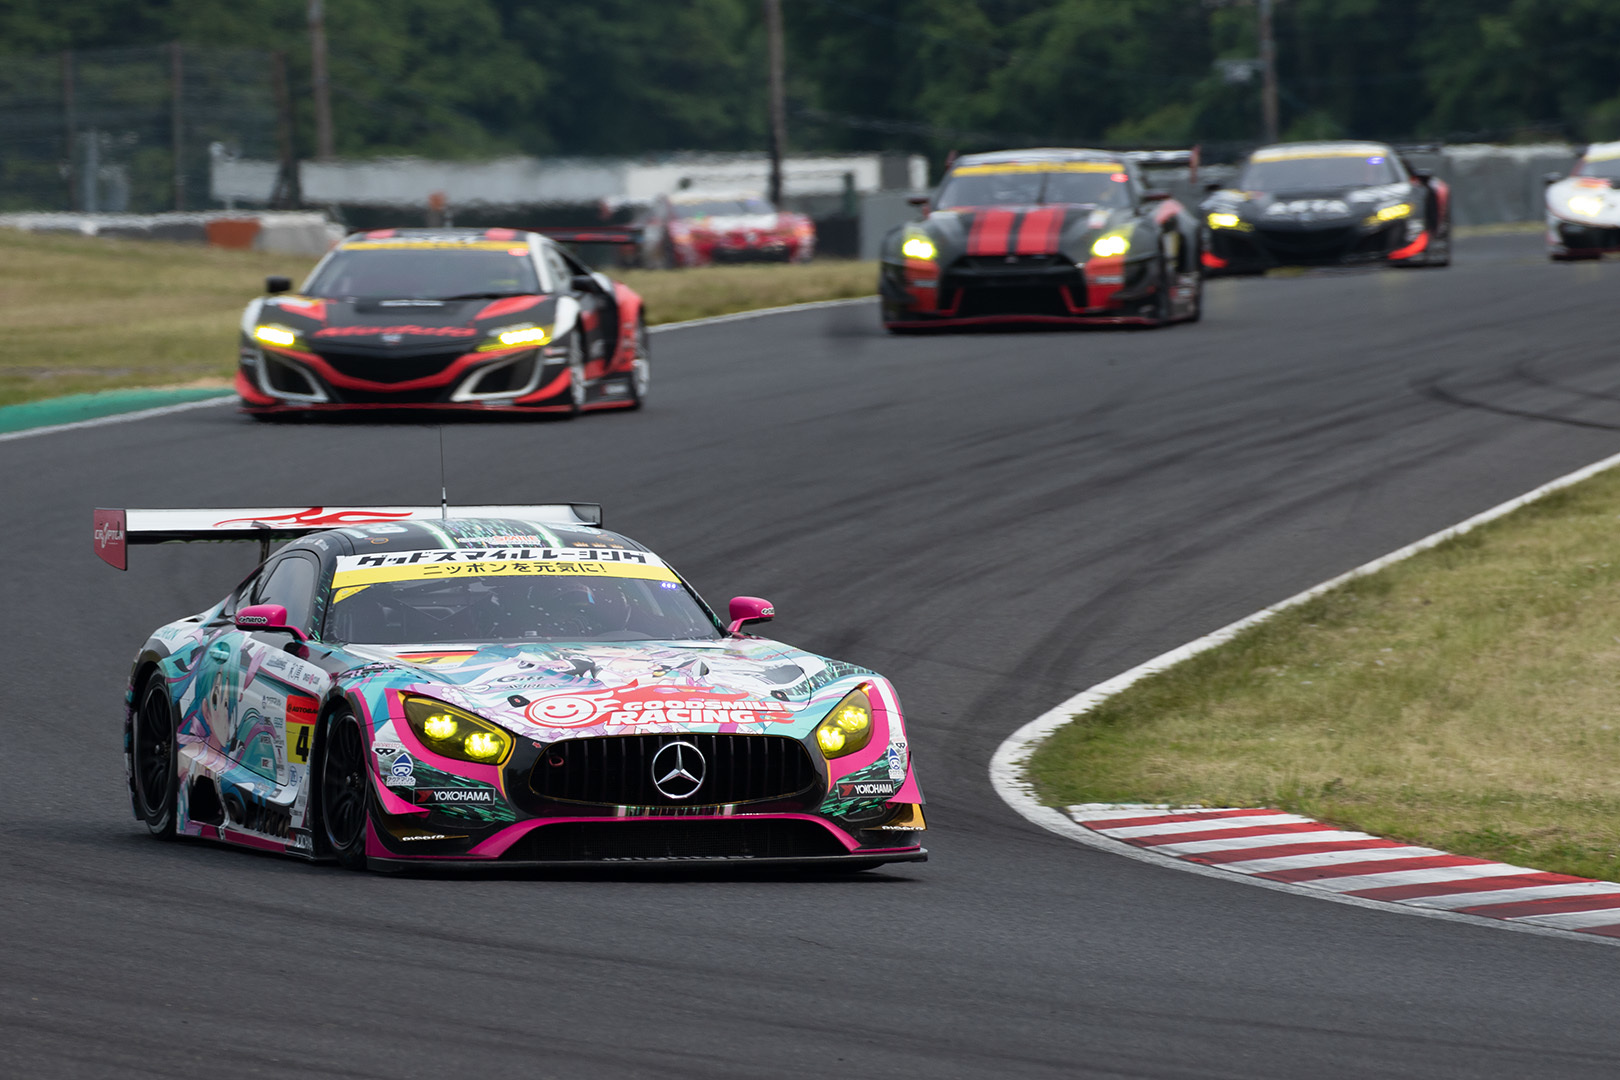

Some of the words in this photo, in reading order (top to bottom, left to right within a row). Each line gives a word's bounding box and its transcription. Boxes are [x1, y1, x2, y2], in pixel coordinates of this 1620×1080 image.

[357, 549, 647, 567] グッドスマイルレーシング
[423, 562, 608, 576] ニッポンを元気に!
[608, 709, 756, 725] RACING
[295, 725, 310, 763] 4
[433, 790, 492, 802] YOKOHAMA
[854, 783, 894, 795] YOKOHAMA
